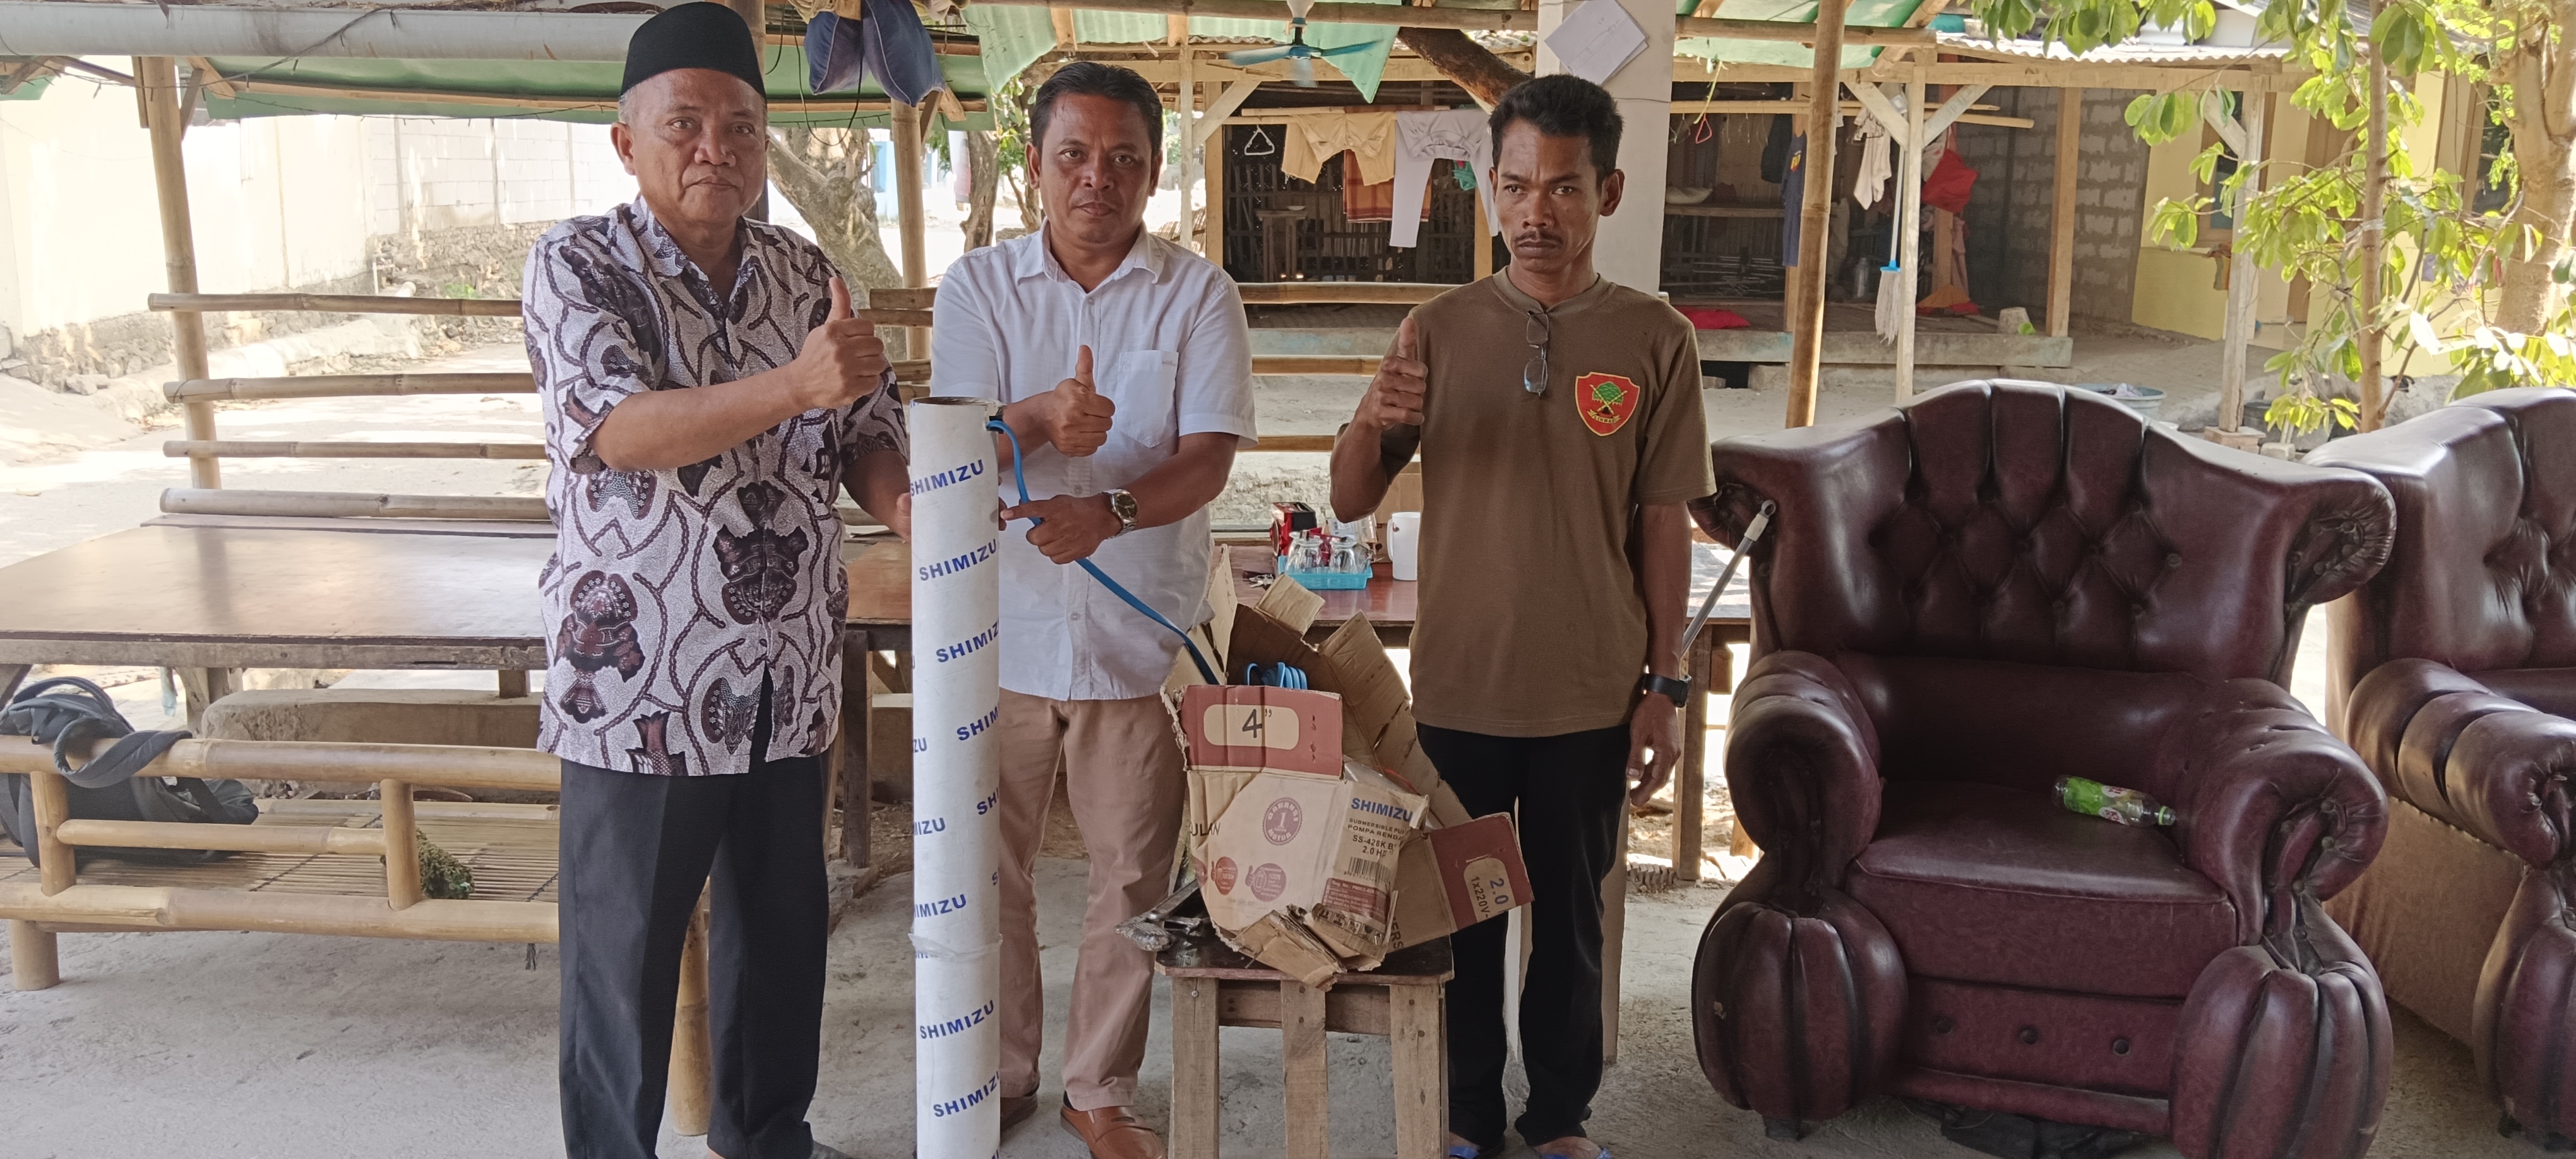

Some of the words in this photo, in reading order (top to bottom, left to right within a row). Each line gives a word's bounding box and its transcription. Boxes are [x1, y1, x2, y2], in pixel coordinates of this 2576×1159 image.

[910, 459, 984, 497] SHIMIZU
[919, 538, 997, 581] SHIMIZU
[936, 617, 999, 663] SHIMIZ
[956, 703, 999, 741] SHIM
[1349, 817, 1393, 832] SUBMERSIBLE
[1351, 797, 1413, 823] SHIMIZU
[1347, 824, 1375, 834] POMPA
[1352, 835, 1386, 849] SS-428K
[1363, 845, 1374, 855] 2.0
[1490, 877, 1510, 905] 2.0
[1390, 917, 1404, 949] ERS
[919, 999, 995, 1040] SHIMIZU
